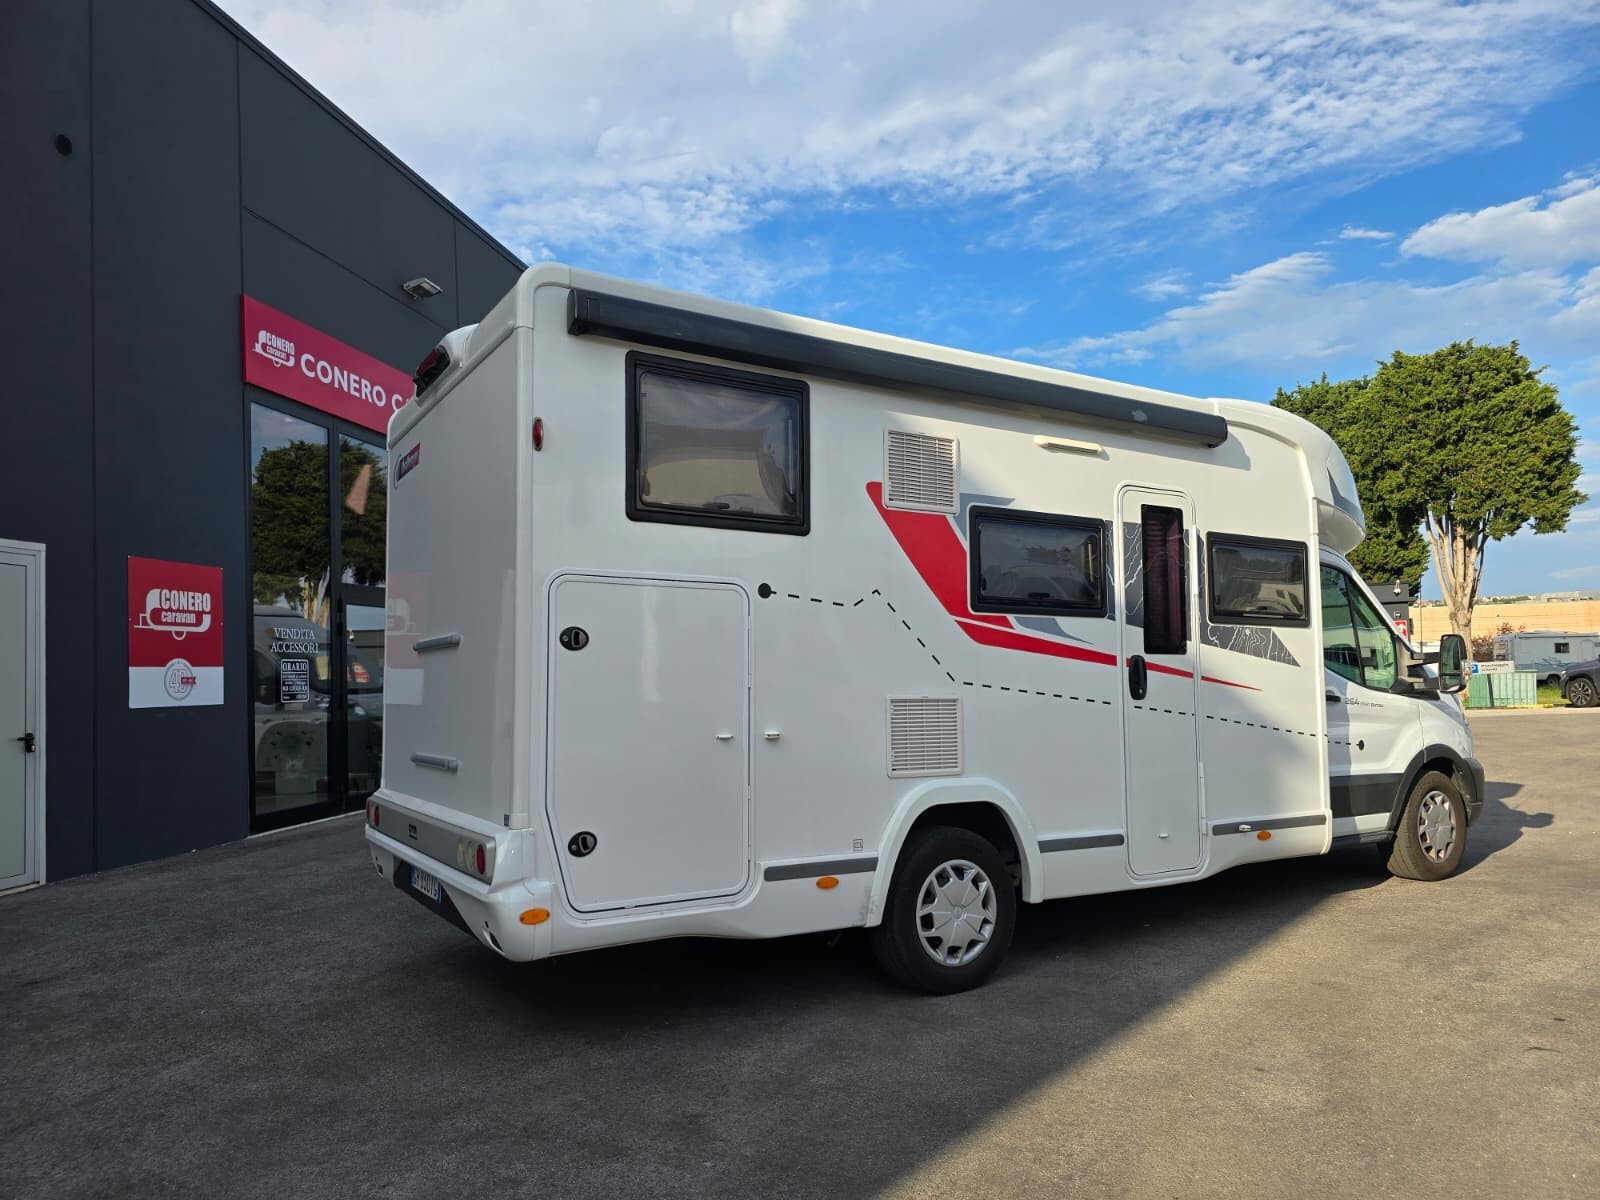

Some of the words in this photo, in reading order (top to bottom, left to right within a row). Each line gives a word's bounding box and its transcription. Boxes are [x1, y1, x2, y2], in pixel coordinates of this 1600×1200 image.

[265, 332, 295, 356] CONERO
[300, 353, 386, 408] CONERO
[160, 588, 211, 613] CONERO
[160, 610, 196, 624] caravan
[273, 627, 316, 641] VENDITA
[271, 641, 319, 654] ACCESSORI
[282, 662, 307, 671] ORARIO
